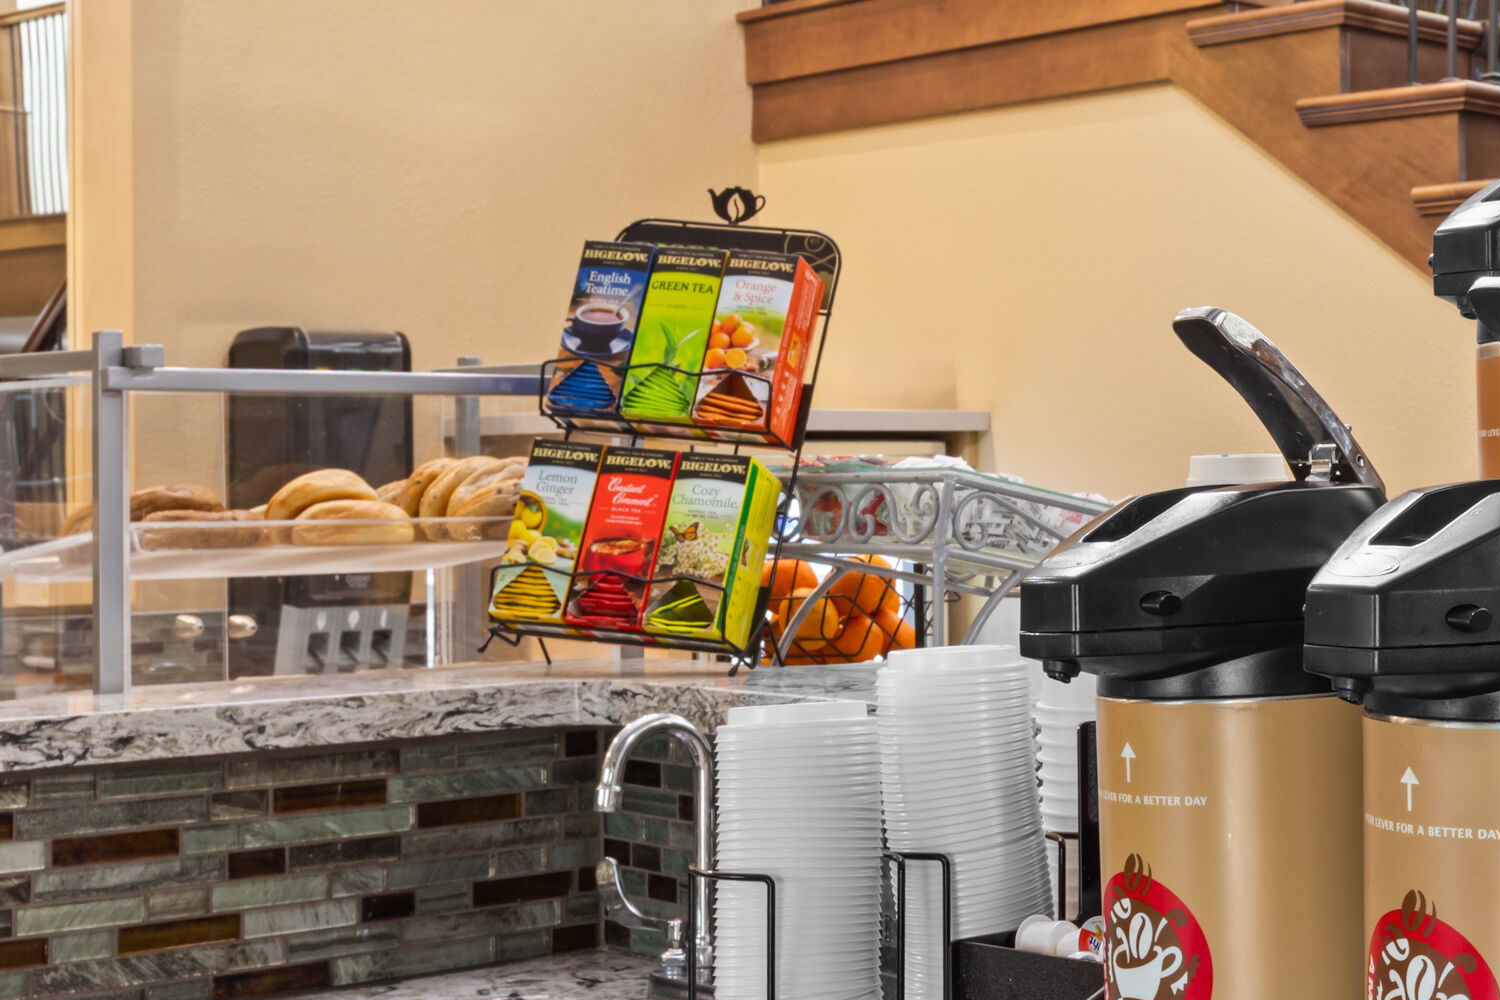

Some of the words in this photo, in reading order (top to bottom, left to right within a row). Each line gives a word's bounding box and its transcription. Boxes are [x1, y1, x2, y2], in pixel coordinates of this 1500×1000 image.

[584, 249, 648, 263] BIGELOW
[657, 255, 721, 268] BIGELOW
[729, 259, 794, 273] BIGELOW
[589, 270, 631, 287] English
[585, 282, 628, 297] Teatime
[651, 281, 689, 292] GREEN
[692, 283, 713, 294] TEA
[736, 279, 776, 295] Orange
[733, 292, 743, 302] &
[744, 292, 774, 305] Spice
[533, 447, 598, 462] BIGELOW
[606, 455, 671, 469] BIGELOW
[681, 461, 746, 474] BIGELOW
[538, 470, 578, 484] Lemon
[536, 481, 575, 497] Ginger
[608, 477, 646, 493] Constant
[692, 484, 720, 499] Cozy
[612, 493, 655, 507] Comment
[672, 494, 737, 509] Chamomile
[1118, 793, 1133, 804] FOR
[1135, 795, 1141, 804] A
[1143, 795, 1181, 806] BETTER
[1184, 796, 1208, 806] DAY
[1375, 817, 1394, 832] LEVER
[1396, 822, 1414, 834] FOR
[1417, 825, 1425, 836] A
[1428, 826, 1473, 839] BETTER
